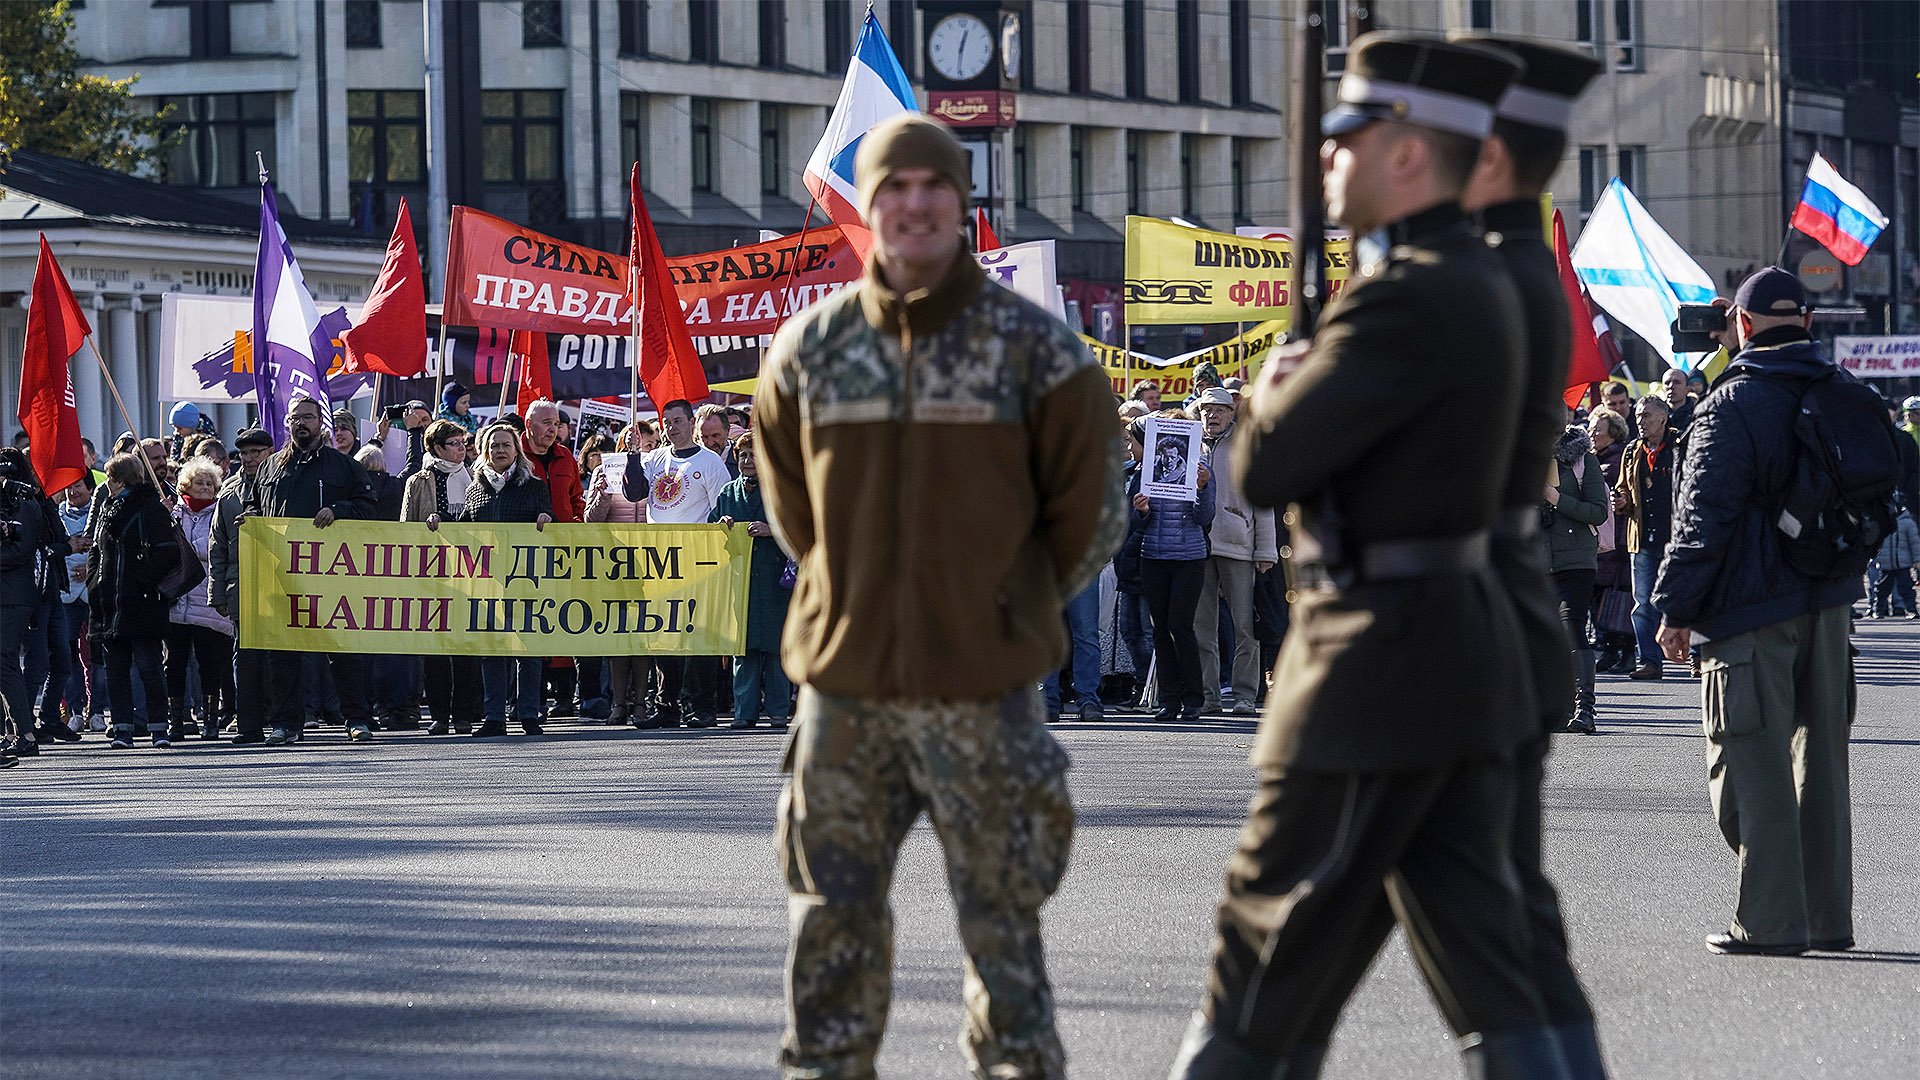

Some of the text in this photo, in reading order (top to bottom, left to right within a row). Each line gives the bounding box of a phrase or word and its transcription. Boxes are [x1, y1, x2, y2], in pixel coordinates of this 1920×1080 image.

[503, 236, 619, 280] СИЛА
[680, 298, 712, 325] А
[286, 540, 494, 579] НАШИМ
[505, 545, 684, 589] ДЕТЯМ
[286, 593, 697, 635] НАШИ ШКОЛЫ!
